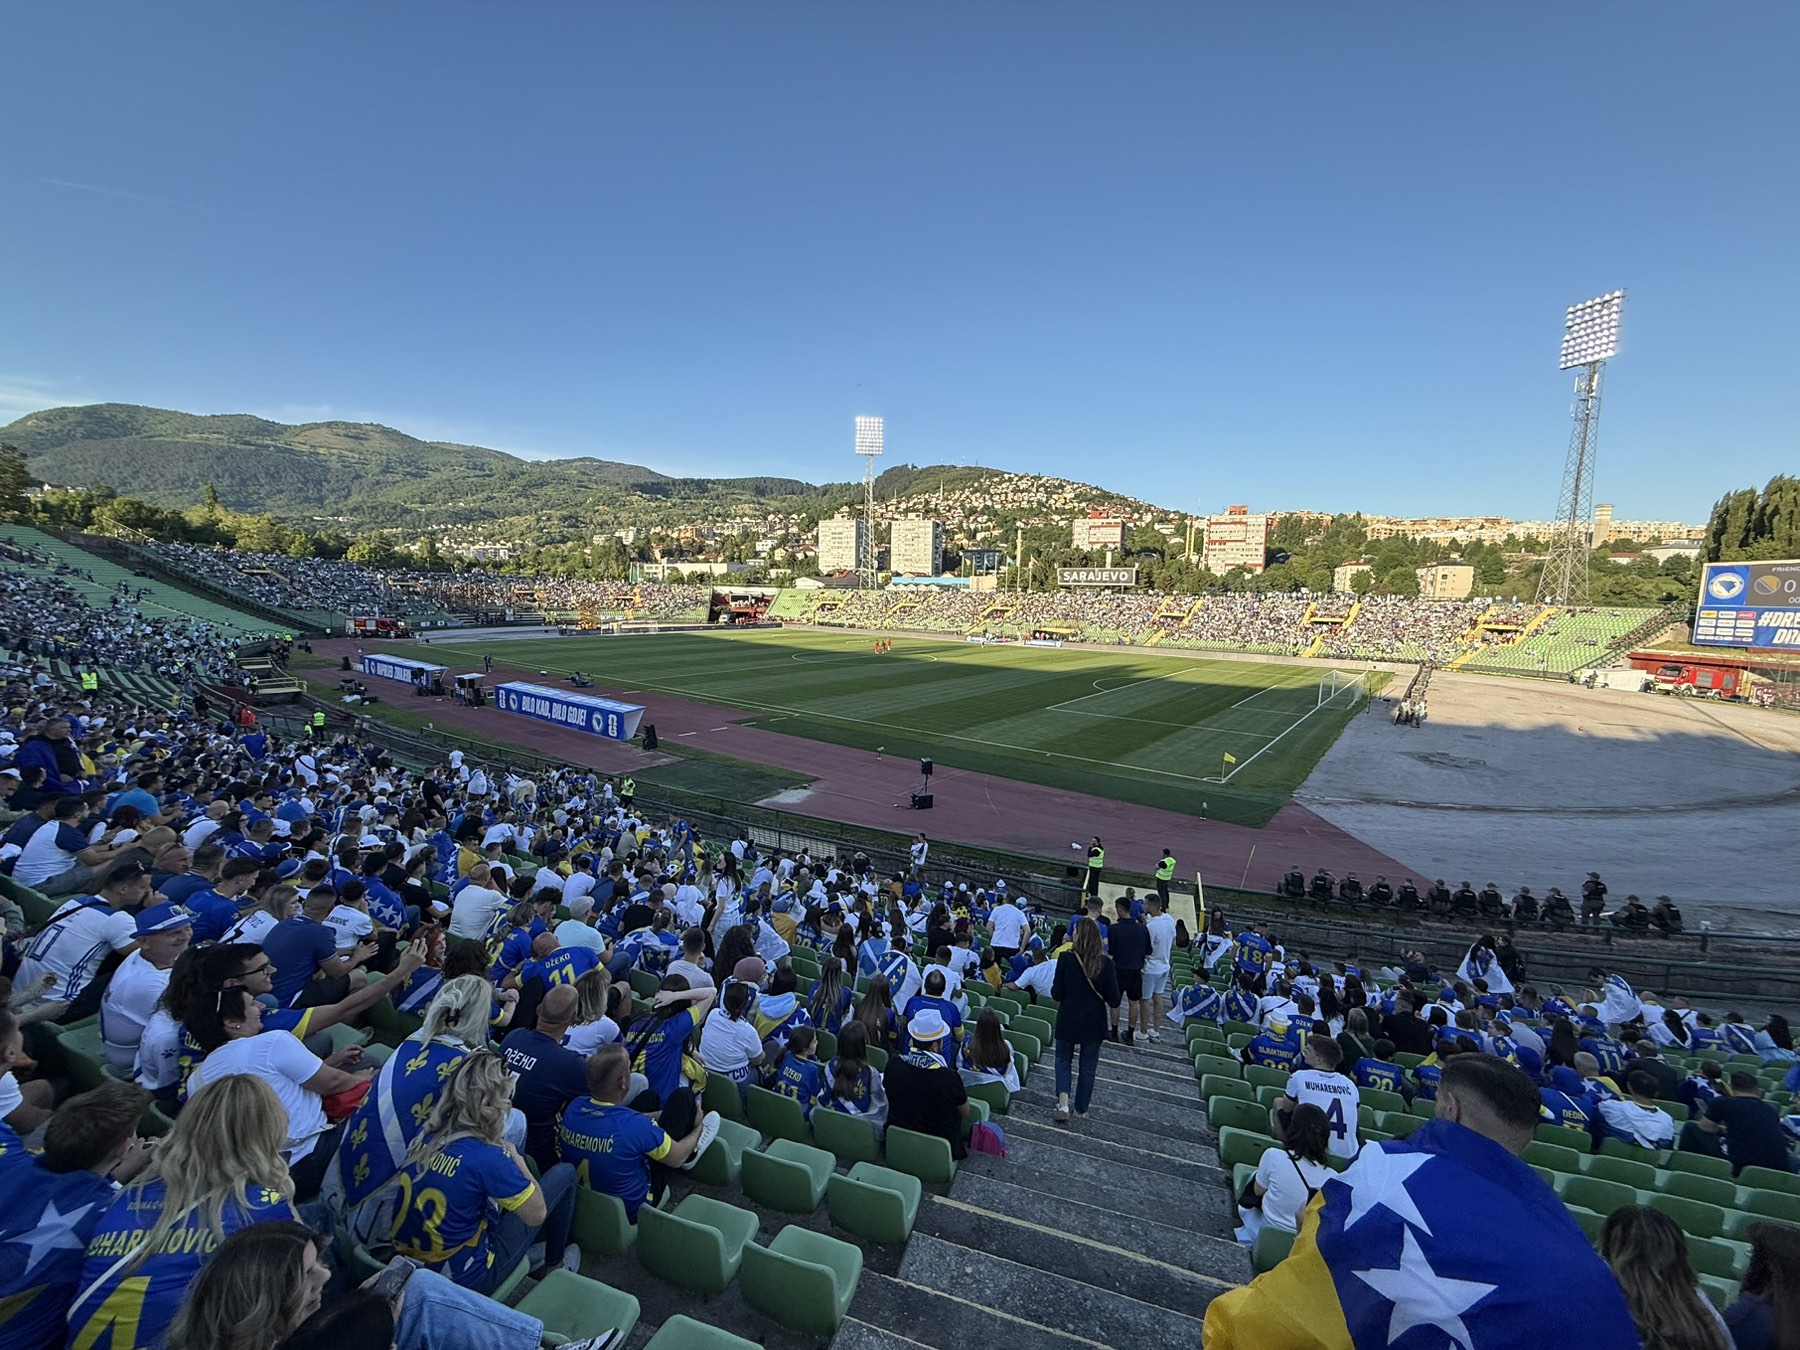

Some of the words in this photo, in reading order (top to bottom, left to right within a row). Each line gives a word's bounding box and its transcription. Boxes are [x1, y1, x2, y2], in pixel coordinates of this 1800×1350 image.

[1063, 571, 1129, 582] SARAJEVO
[1784, 580, 1796, 593] 0
[521, 695, 535, 713] BILO
[535, 698, 551, 719] KAD,
[551, 702, 567, 721] BILO
[567, 705, 587, 727] GDJE!
[544, 952, 571, 968] DŽEKO
[1241, 945, 1263, 965] 18
[548, 963, 576, 988] 11
[1304, 1080, 1352, 1096] MUHAREMOVIĆ
[1325, 1098, 1348, 1141] 4
